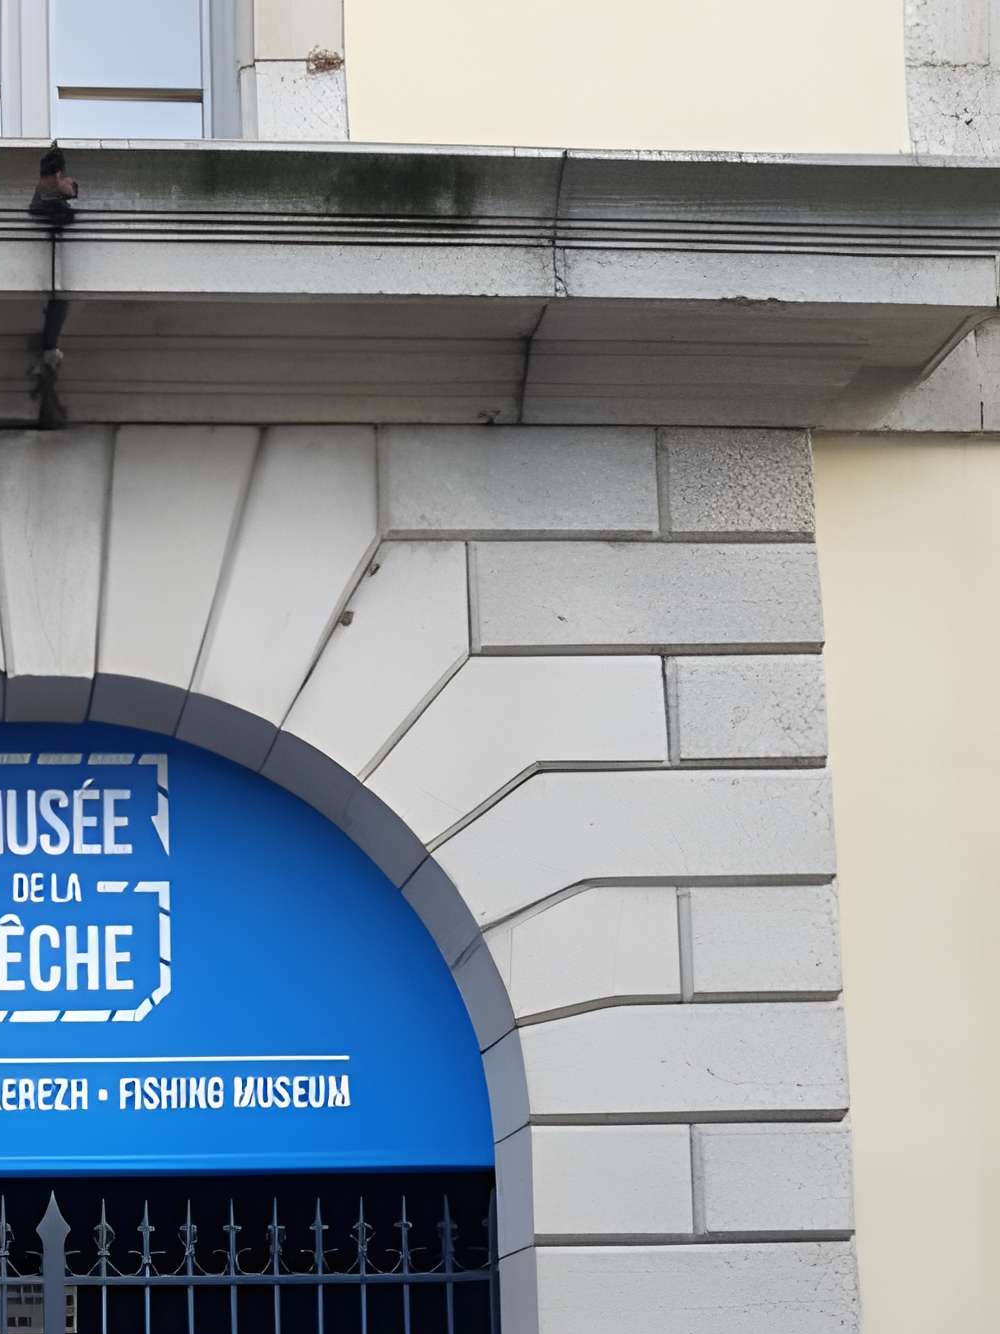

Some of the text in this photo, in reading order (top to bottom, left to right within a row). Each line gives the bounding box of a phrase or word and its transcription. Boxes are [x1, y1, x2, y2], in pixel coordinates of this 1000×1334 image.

[12, 872, 83, 903] DE LA
[119, 1076, 225, 1110] FISHING
[233, 1074, 351, 1108] MUSEUM
